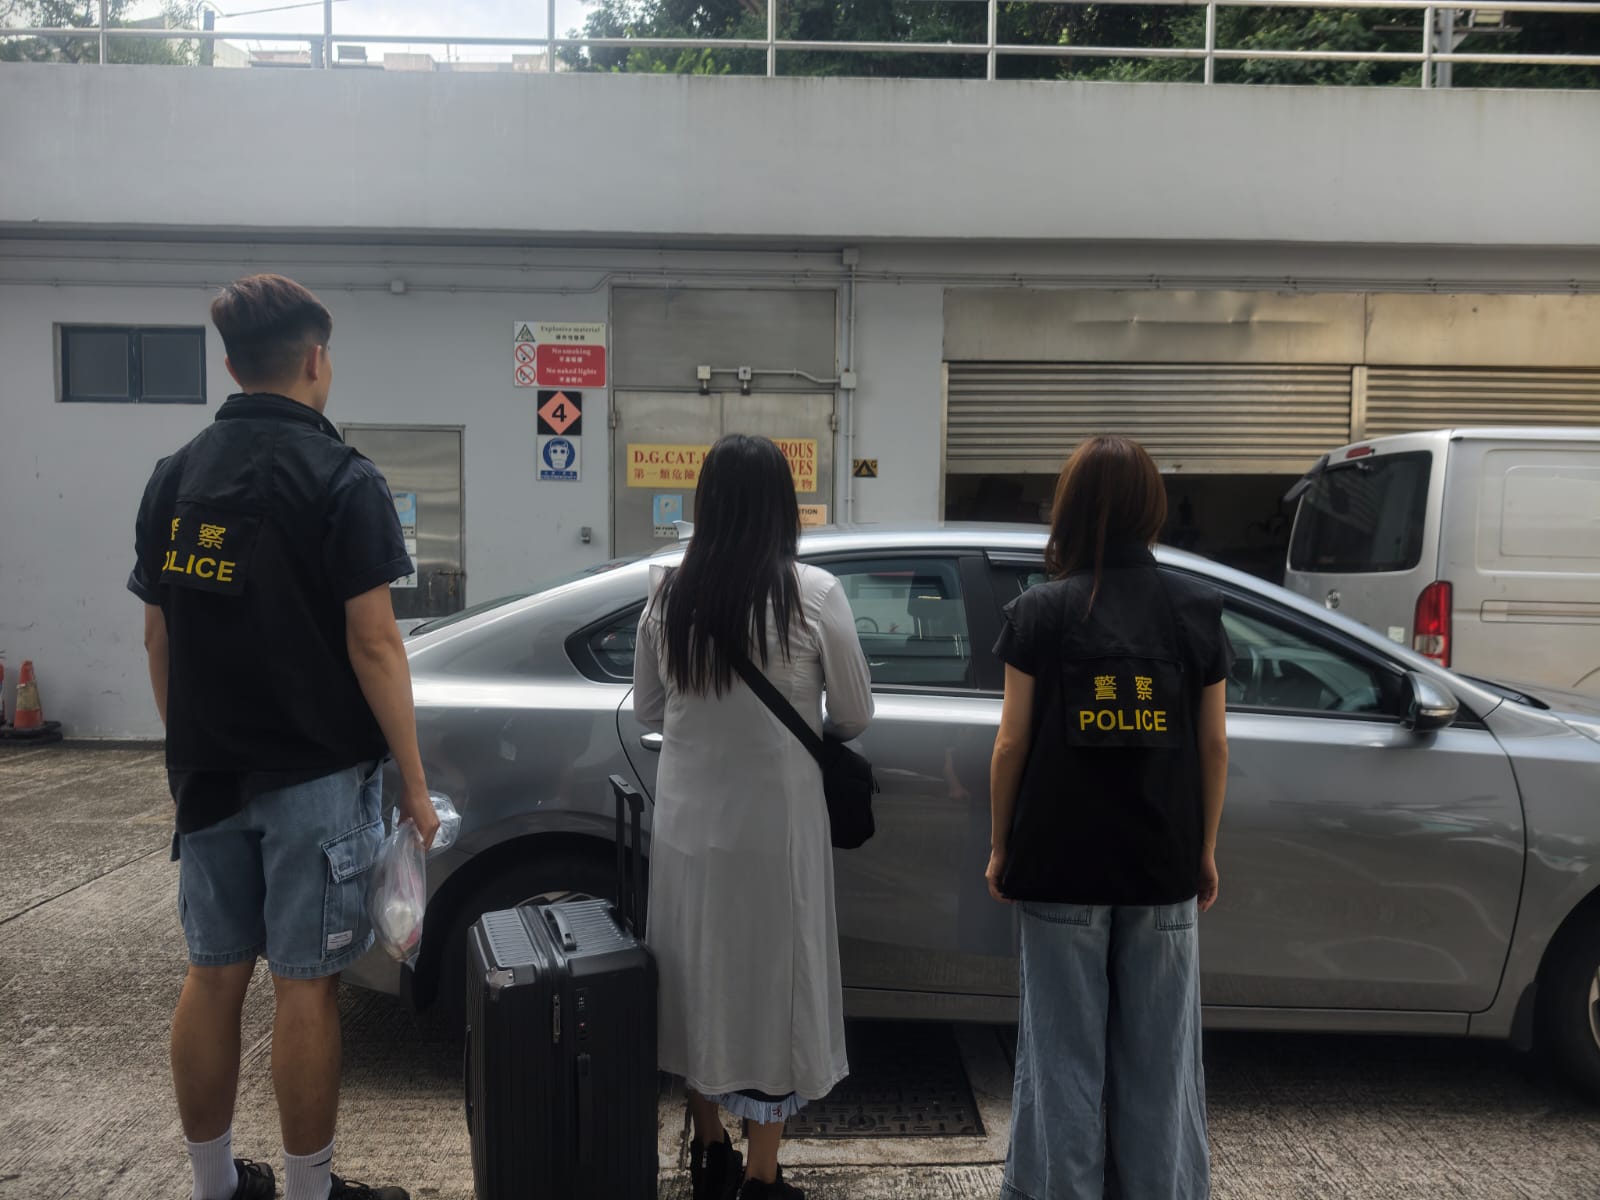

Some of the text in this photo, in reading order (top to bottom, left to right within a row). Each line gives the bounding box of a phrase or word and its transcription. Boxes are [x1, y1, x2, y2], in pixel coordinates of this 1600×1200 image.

[552, 347, 591, 357] No smoking
[546, 367, 597, 376] No naked lights
[551, 403, 567, 423] 4
[778, 442, 814, 459] ROUS
[791, 459, 814, 476] VES
[1093, 674, 1153, 701] 警察
[1079, 709, 1168, 732] POLICE
